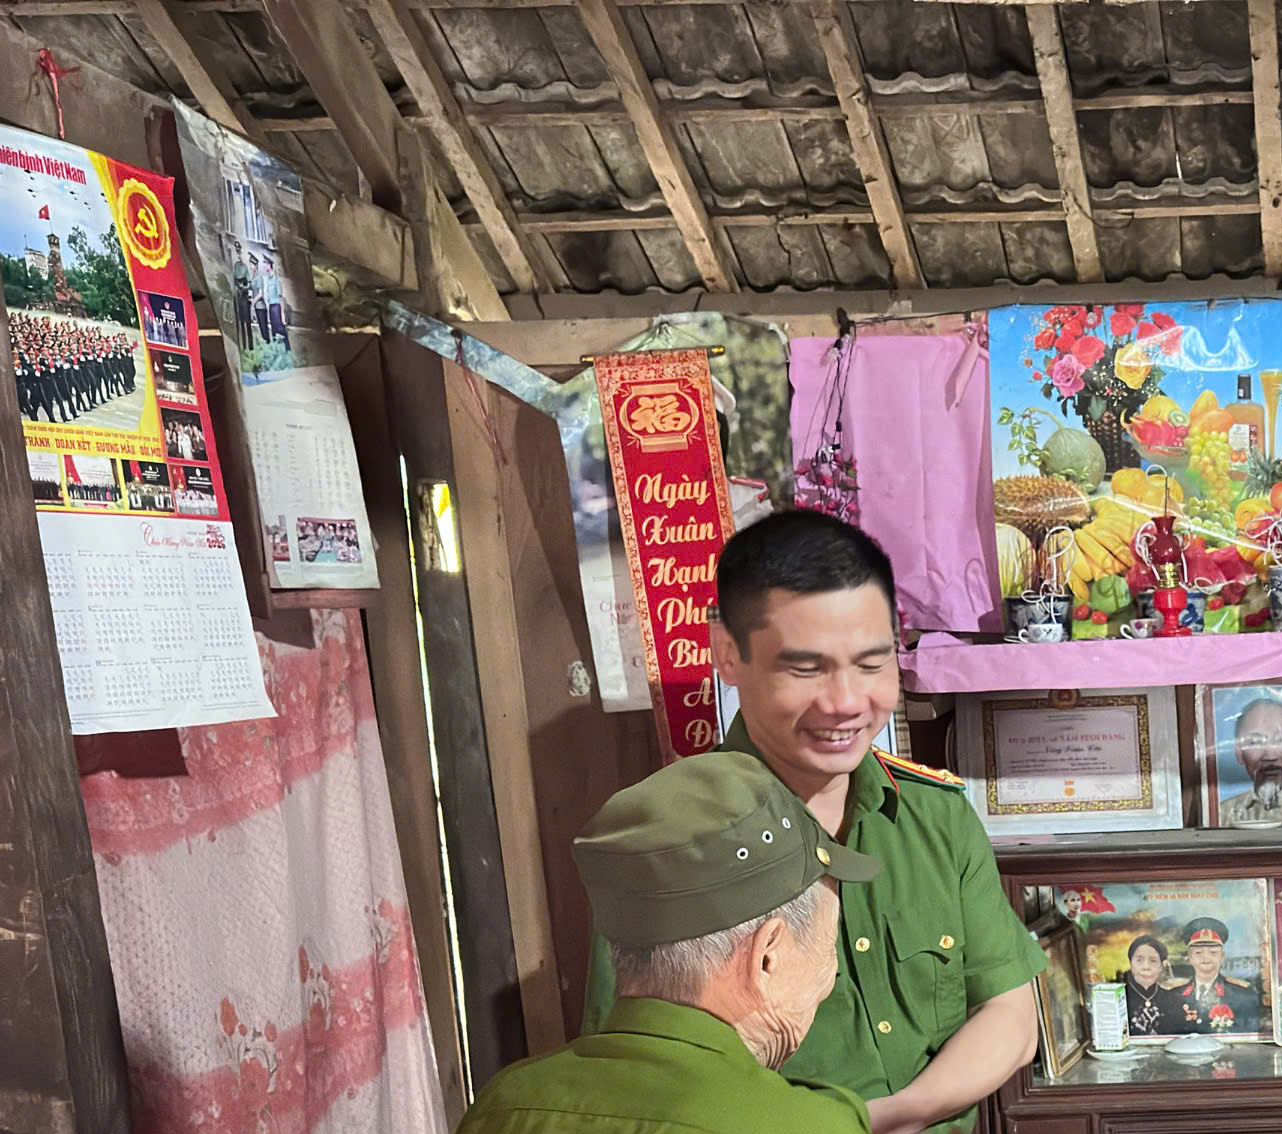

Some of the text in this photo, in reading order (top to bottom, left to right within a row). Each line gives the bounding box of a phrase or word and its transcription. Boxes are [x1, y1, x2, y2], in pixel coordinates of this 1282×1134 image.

[42, 155, 66, 180] Việt
[63, 161, 87, 185] Nam
[630, 394, 691, 434] 福
[635, 473, 711, 509] Ngày
[642, 515, 717, 546] Xuân
[668, 638, 713, 669] Bìn
